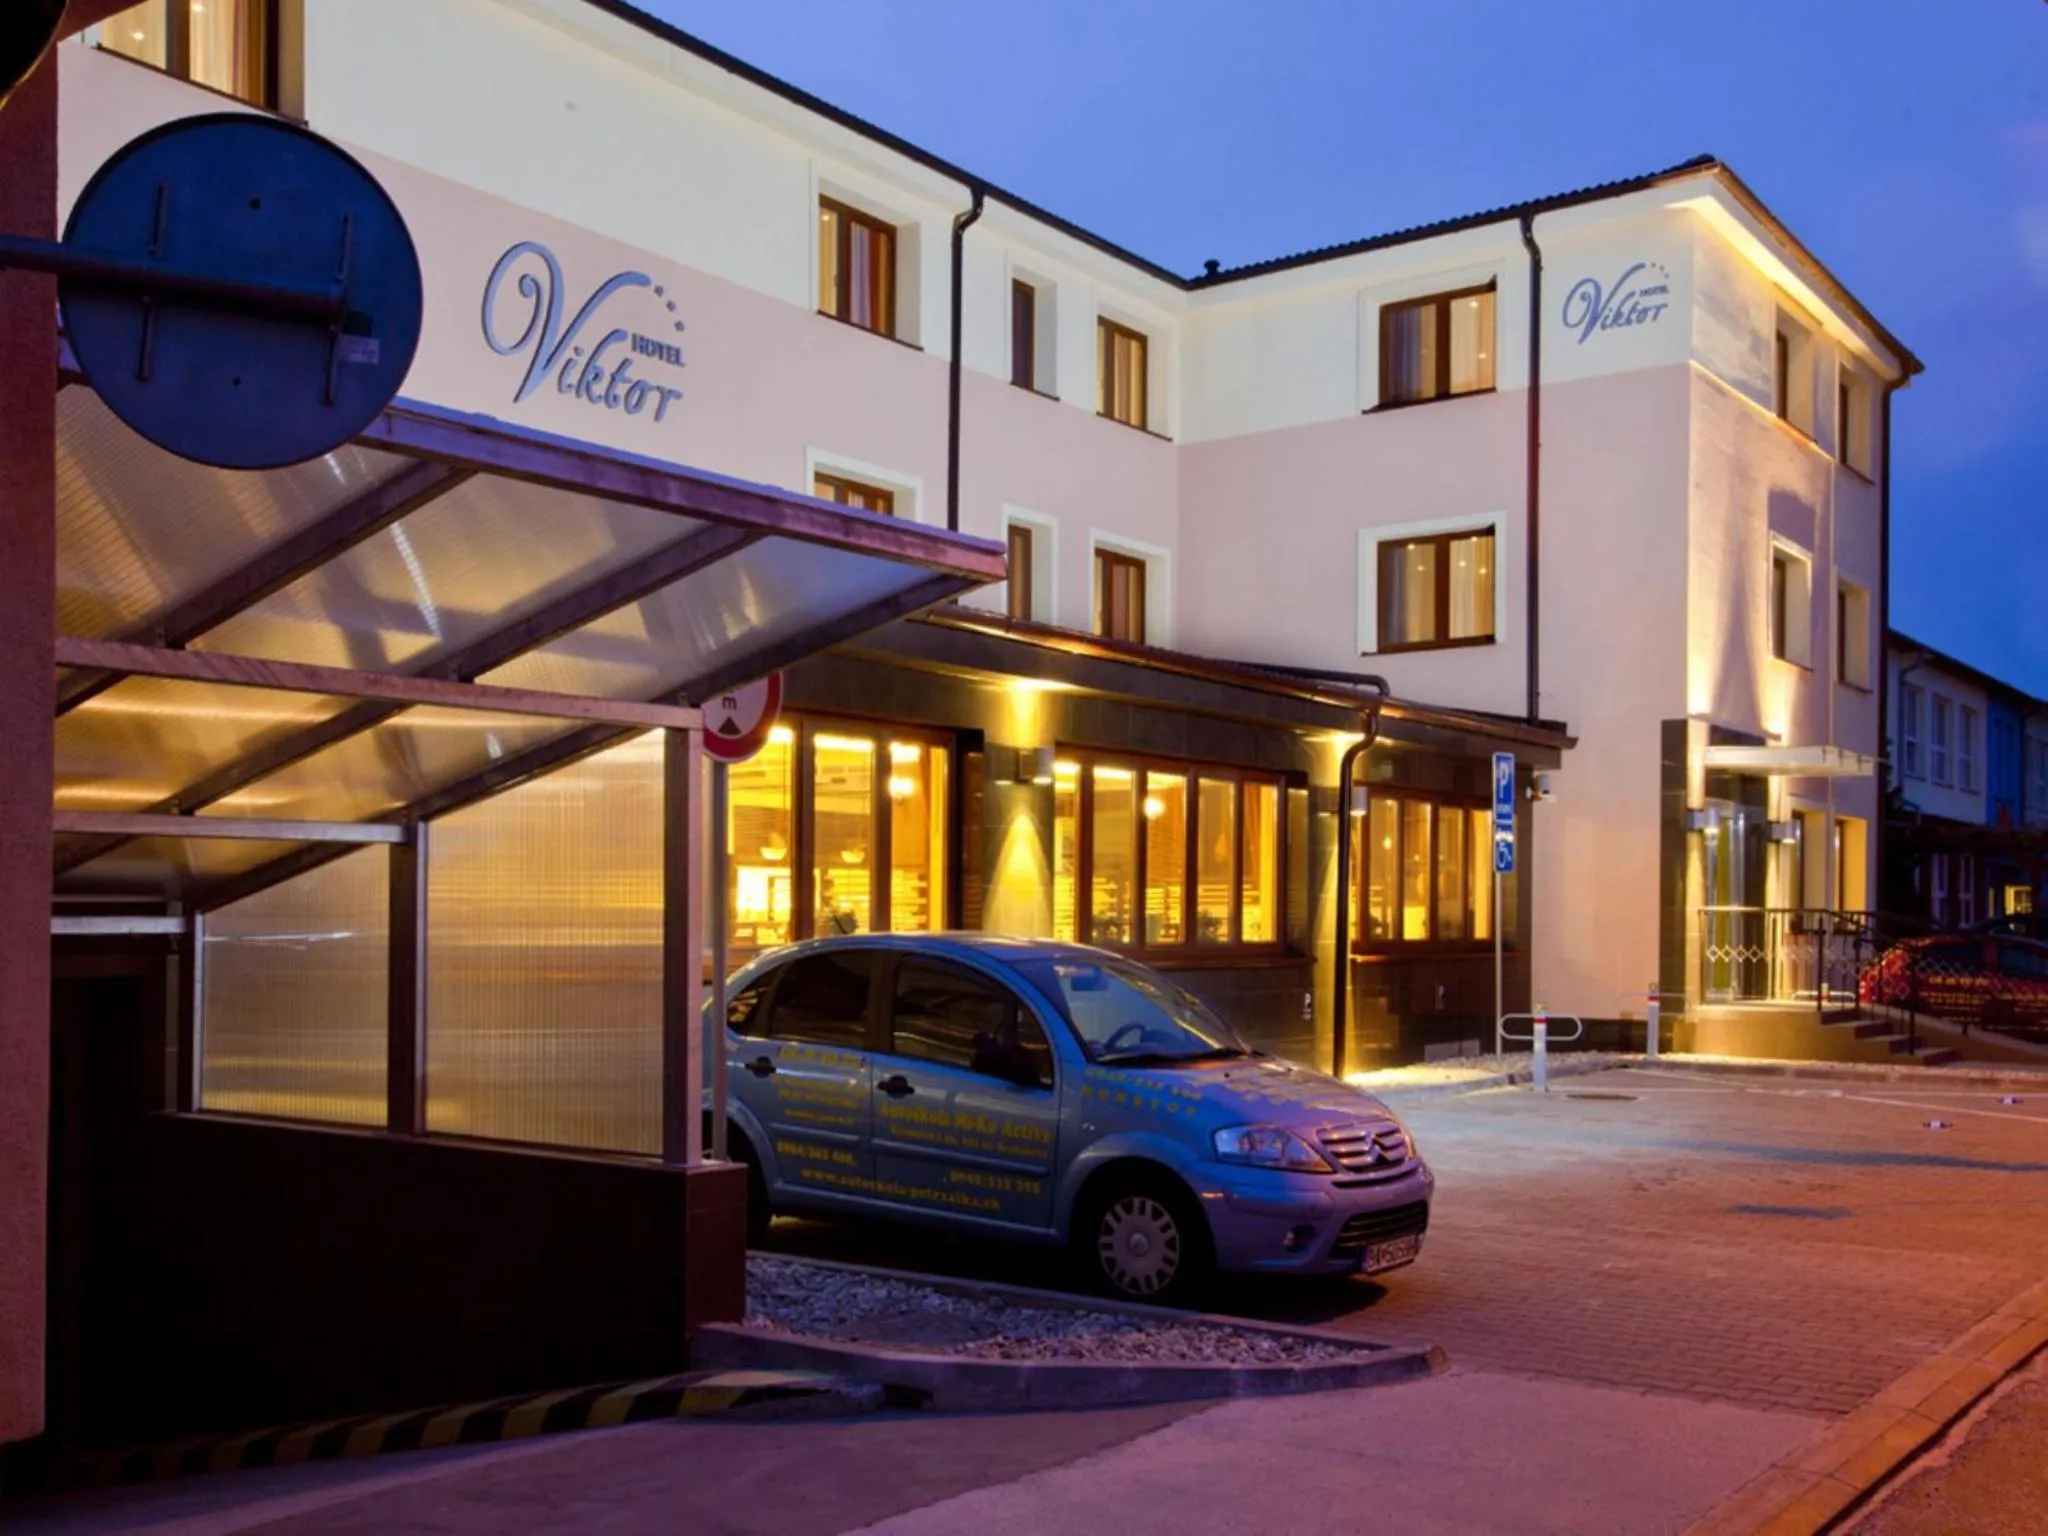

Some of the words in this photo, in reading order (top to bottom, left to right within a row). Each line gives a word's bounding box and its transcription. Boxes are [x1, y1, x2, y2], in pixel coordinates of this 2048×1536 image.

[482, 241, 684, 422] Viktor
[1562, 262, 1669, 345] Viktor
[631, 332, 686, 368] HOTEL
